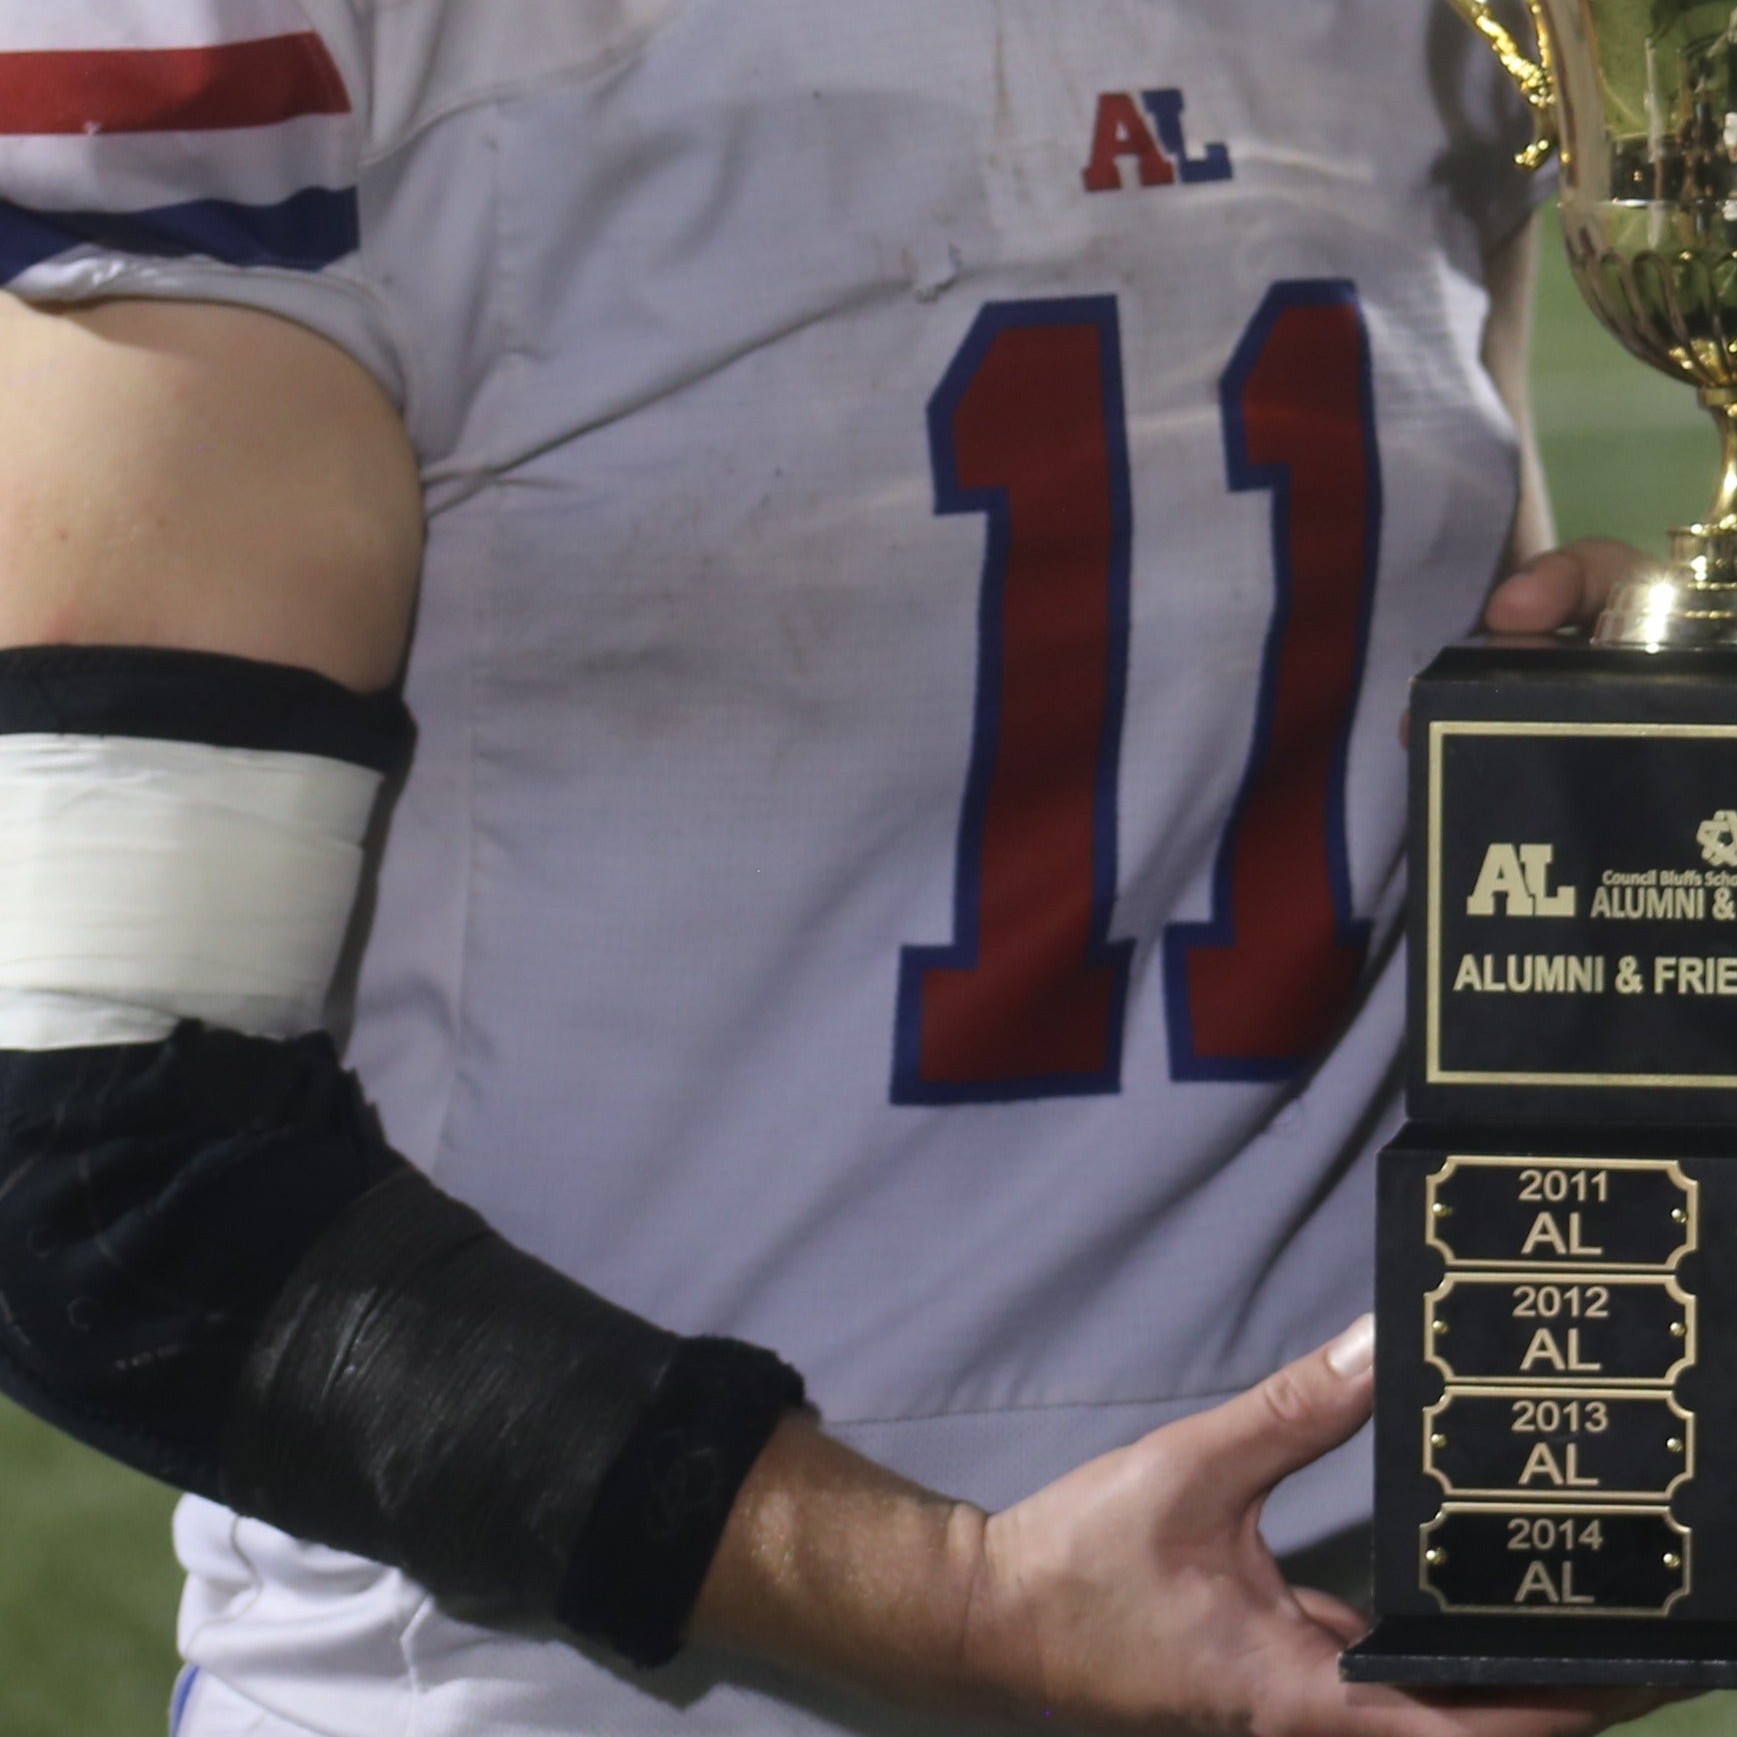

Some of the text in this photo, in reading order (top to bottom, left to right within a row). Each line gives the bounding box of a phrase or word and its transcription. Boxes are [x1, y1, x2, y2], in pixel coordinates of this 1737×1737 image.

[1083, 88, 1232, 191] AL
[891, 277, 1383, 1105] 11
[1467, 843, 1576, 917] AL
[1602, 870, 1656, 885] Council
[1660, 870, 1701, 886] Bluffs
[1590, 886, 1704, 919] ALUMNI
[1711, 888, 1736, 920] &
[1453, 955, 1603, 993] ALUMNI
[1615, 957, 1643, 994] &
[1518, 1170, 1608, 1202] 2011
[1520, 1212, 1603, 1256] AL
[1512, 1286, 1609, 1319] 2012
[1519, 1328, 1602, 1371] AL
[1511, 1401, 1608, 1433] 2013
[1518, 1443, 1600, 1486] AL
[1507, 1519, 1602, 1551] 2014
[1514, 1561, 1595, 1604] AL
